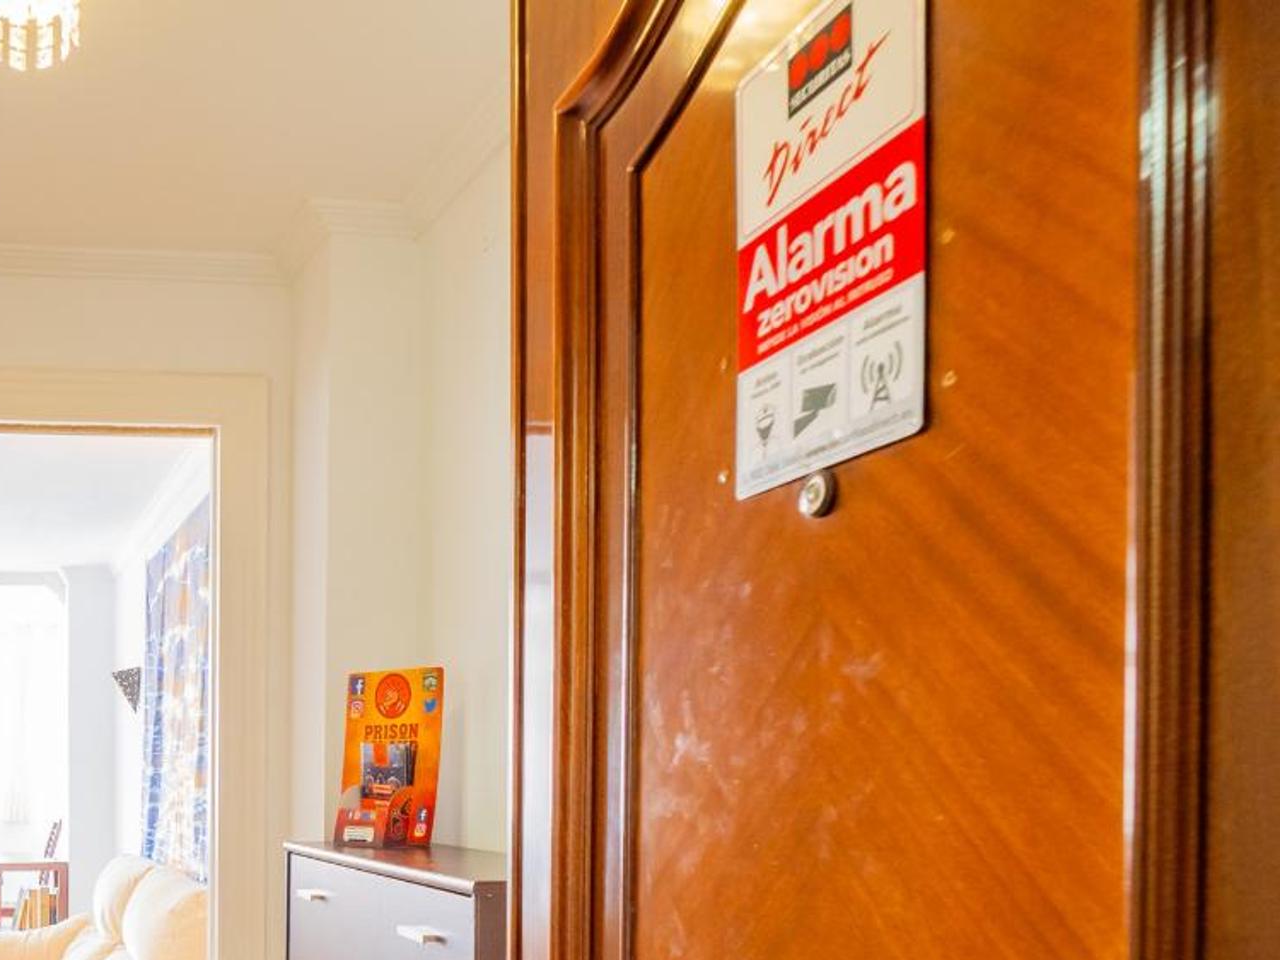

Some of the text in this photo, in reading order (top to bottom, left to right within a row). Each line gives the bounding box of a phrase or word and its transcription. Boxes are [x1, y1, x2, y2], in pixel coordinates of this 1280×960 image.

[763, 28, 891, 206] Direct
[743, 161, 917, 314] Alarma
[757, 233, 895, 338] zerovision
[364, 723, 419, 739] PRISON
